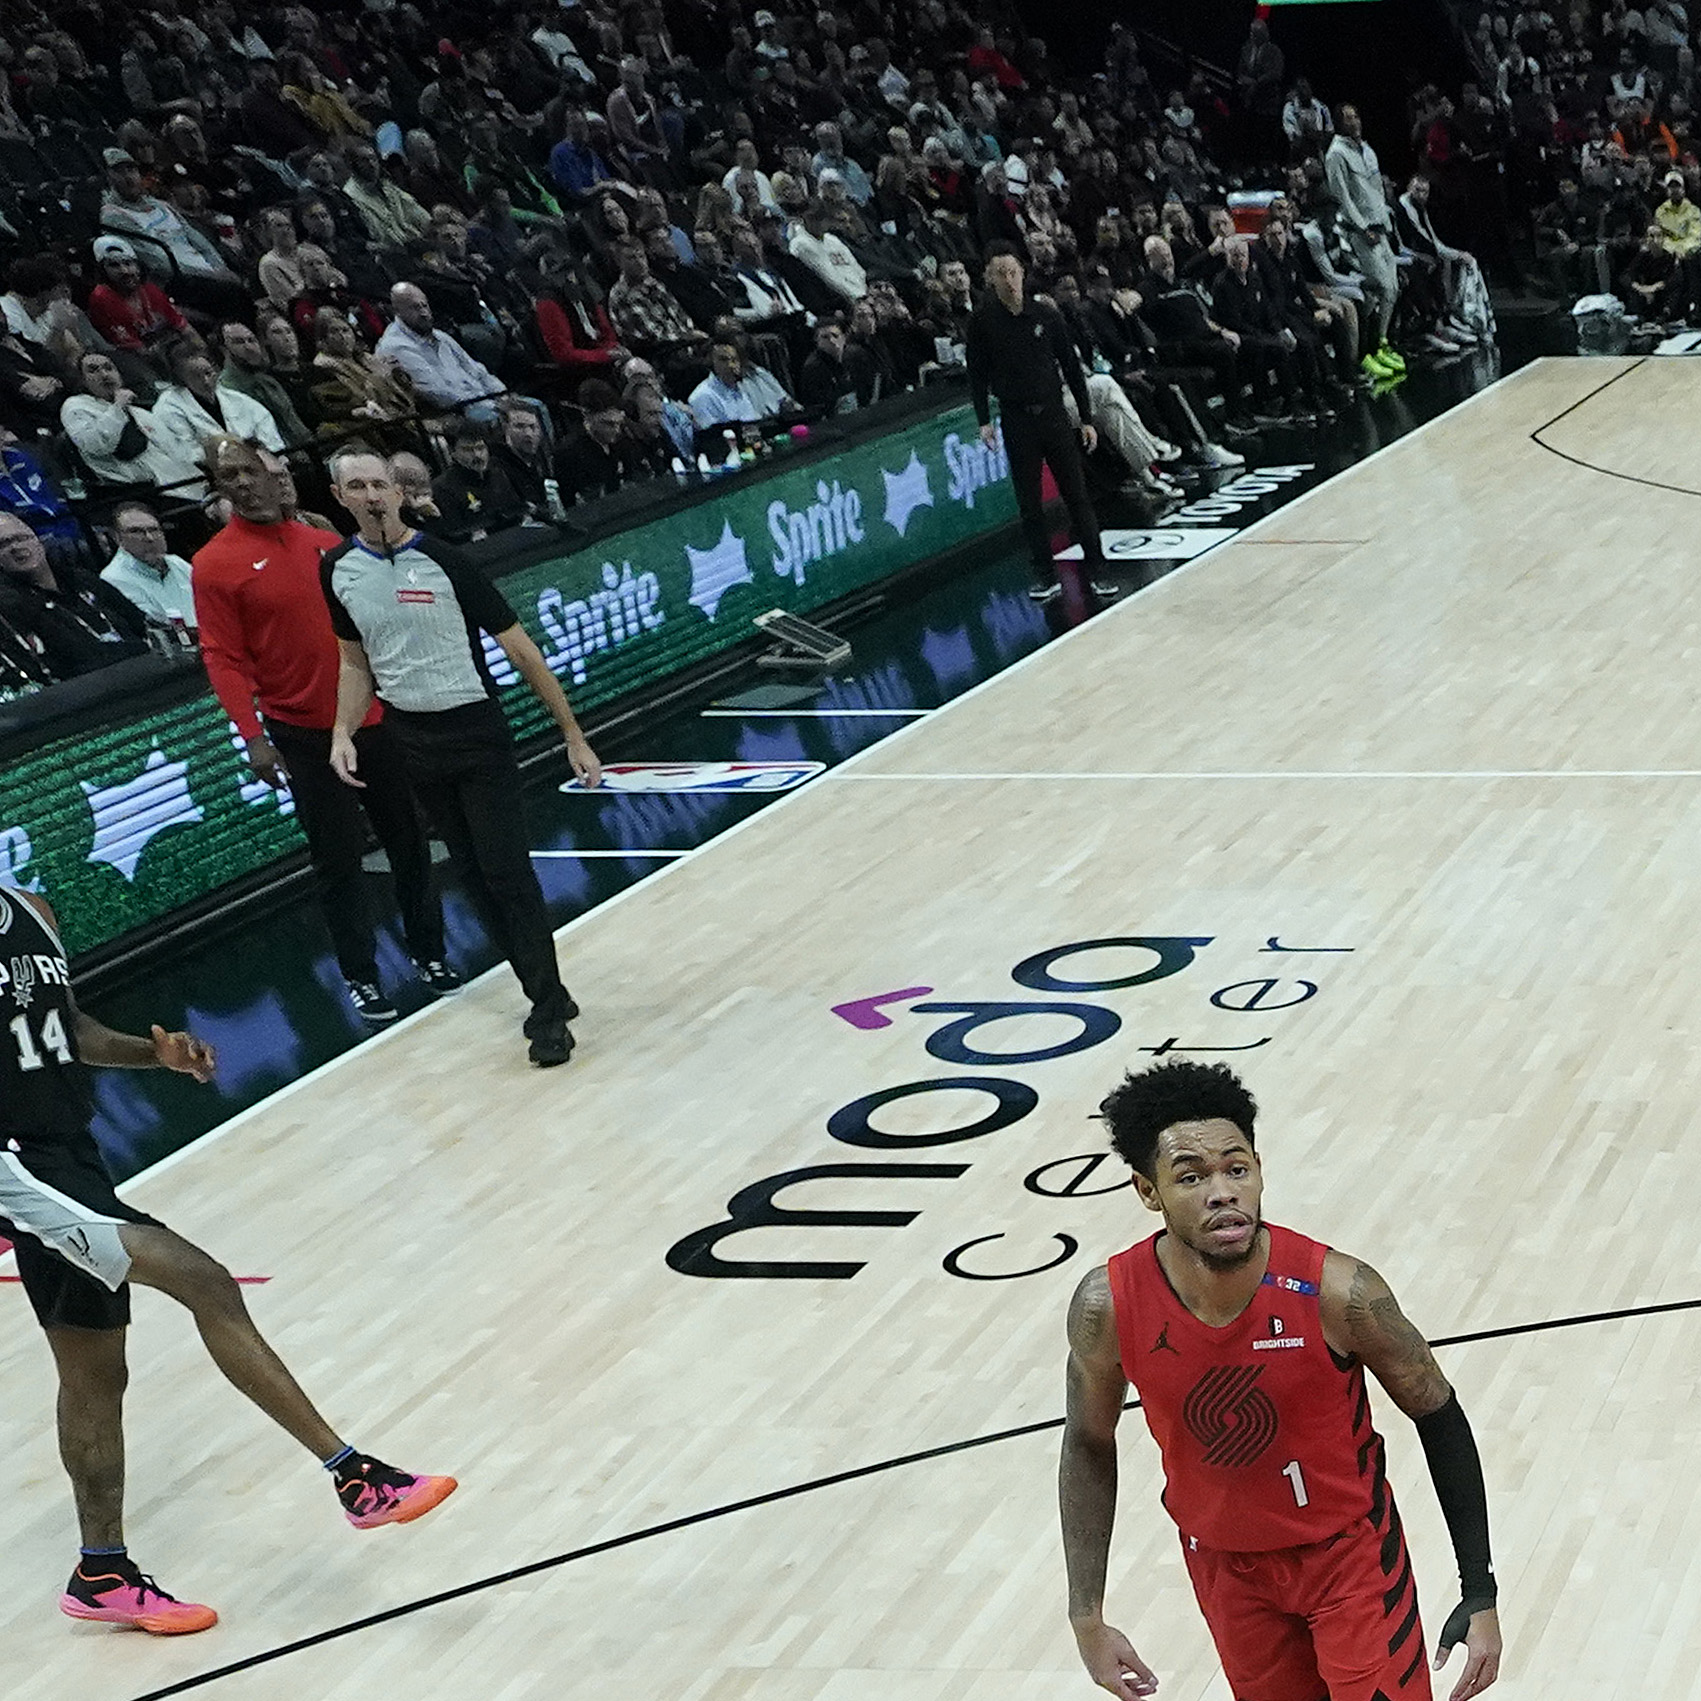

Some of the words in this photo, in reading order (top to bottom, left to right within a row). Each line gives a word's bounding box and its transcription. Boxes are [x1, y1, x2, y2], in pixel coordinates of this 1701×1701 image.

[768, 479, 866, 587] Sprite
[1156, 463, 1316, 527] TOYOTA
[536, 559, 667, 685] Sprite
[8, 1007, 75, 1073] 14
[665, 936, 1217, 1280] moda
[941, 936, 1356, 1281] ceter
[1284, 1277, 1301, 1292] 32
[1281, 1460, 1310, 1508] 1
